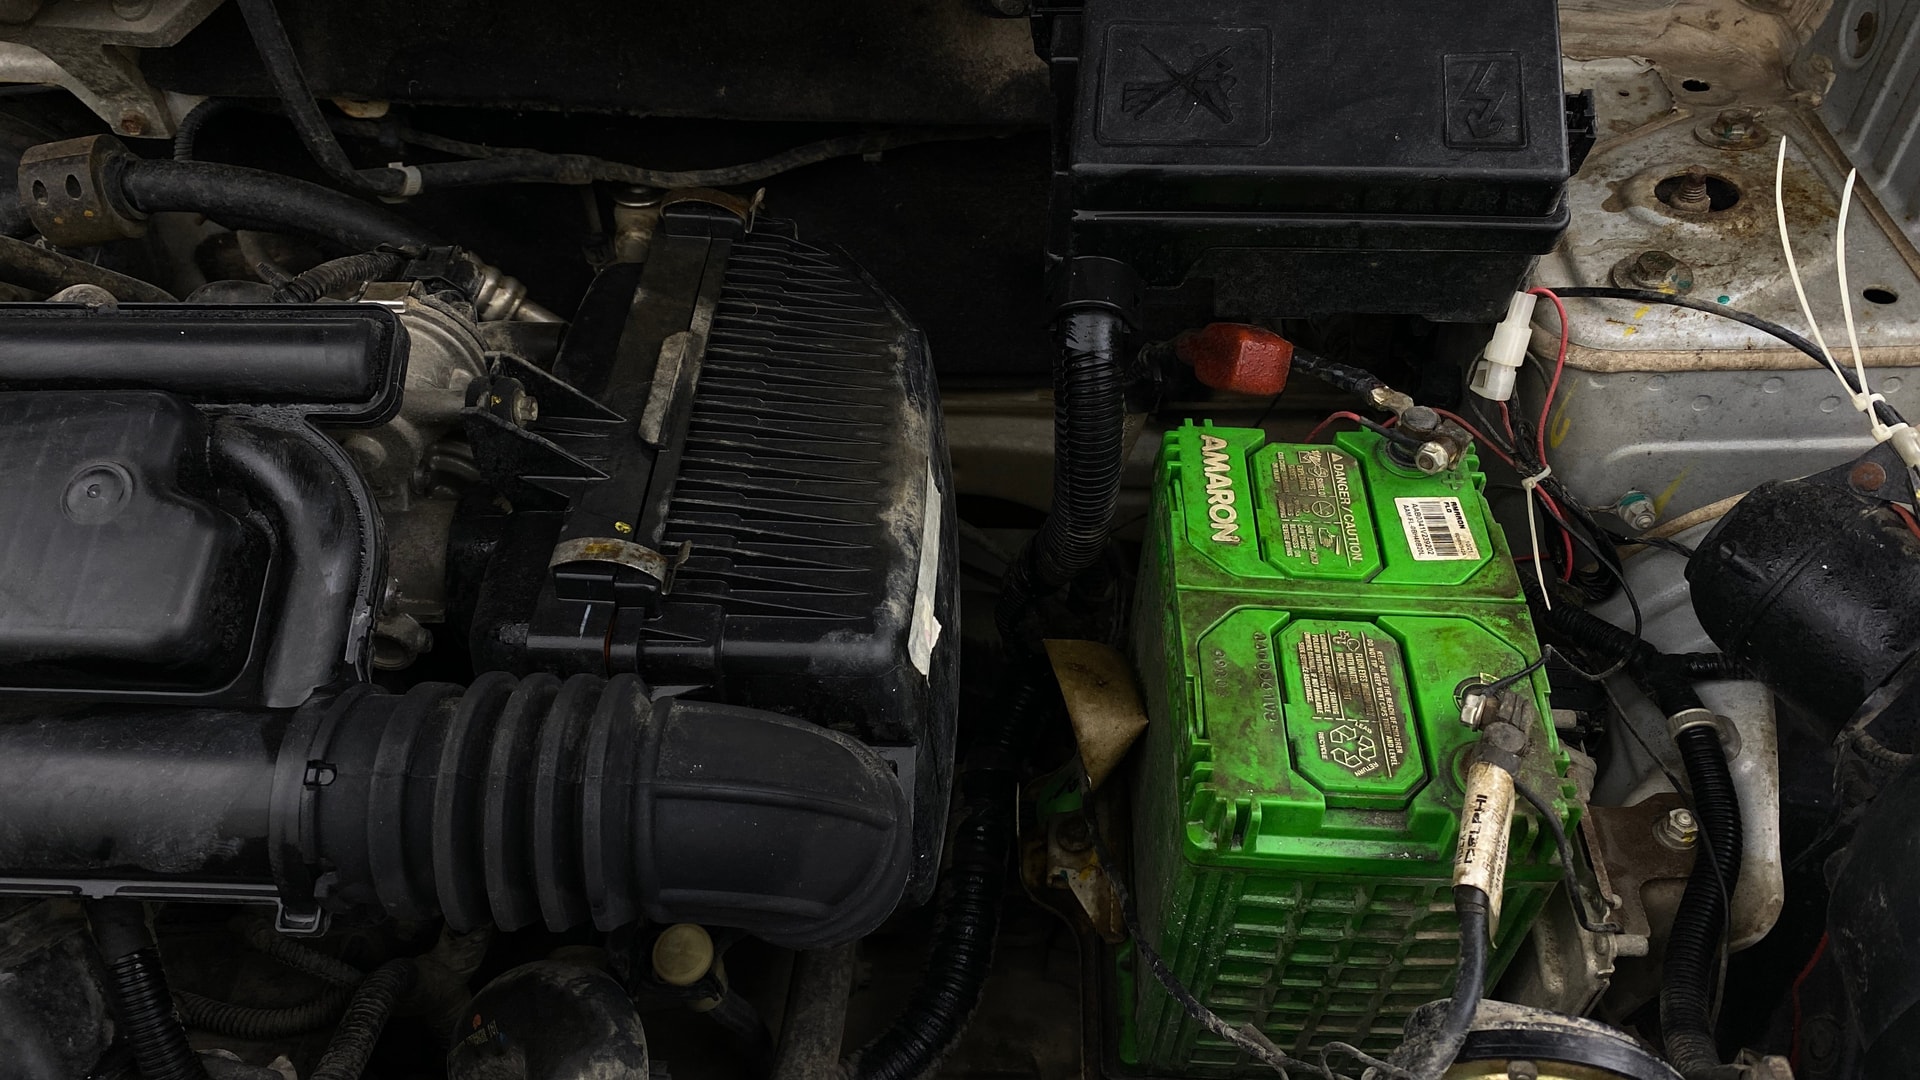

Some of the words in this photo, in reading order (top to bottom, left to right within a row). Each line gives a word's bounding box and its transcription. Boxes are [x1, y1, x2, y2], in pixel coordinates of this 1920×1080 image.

[1199, 434, 1241, 542] AMARON
[1333, 464, 1351, 505] DANGER
[1343, 515, 1362, 560] CAUTION
[1443, 501, 1452, 512] FLO
[1450, 501, 1465, 528] AMARON
[1368, 648, 1376, 658] NOT
[1376, 650, 1385, 664] KEEP
[1358, 669, 1367, 682] EYES
[1379, 664, 1387, 676] OUT
[1373, 672, 1382, 686] KEEP
[1376, 687, 1384, 699] VENT
[1383, 686, 1391, 696] THE
[1379, 701, 1388, 716] CAPS
[1354, 721, 1372, 734] LEAD
[1317, 732, 1328, 759] RECYCLE
[1386, 735, 1394, 747] AND
[1353, 761, 1378, 777] RETURN
